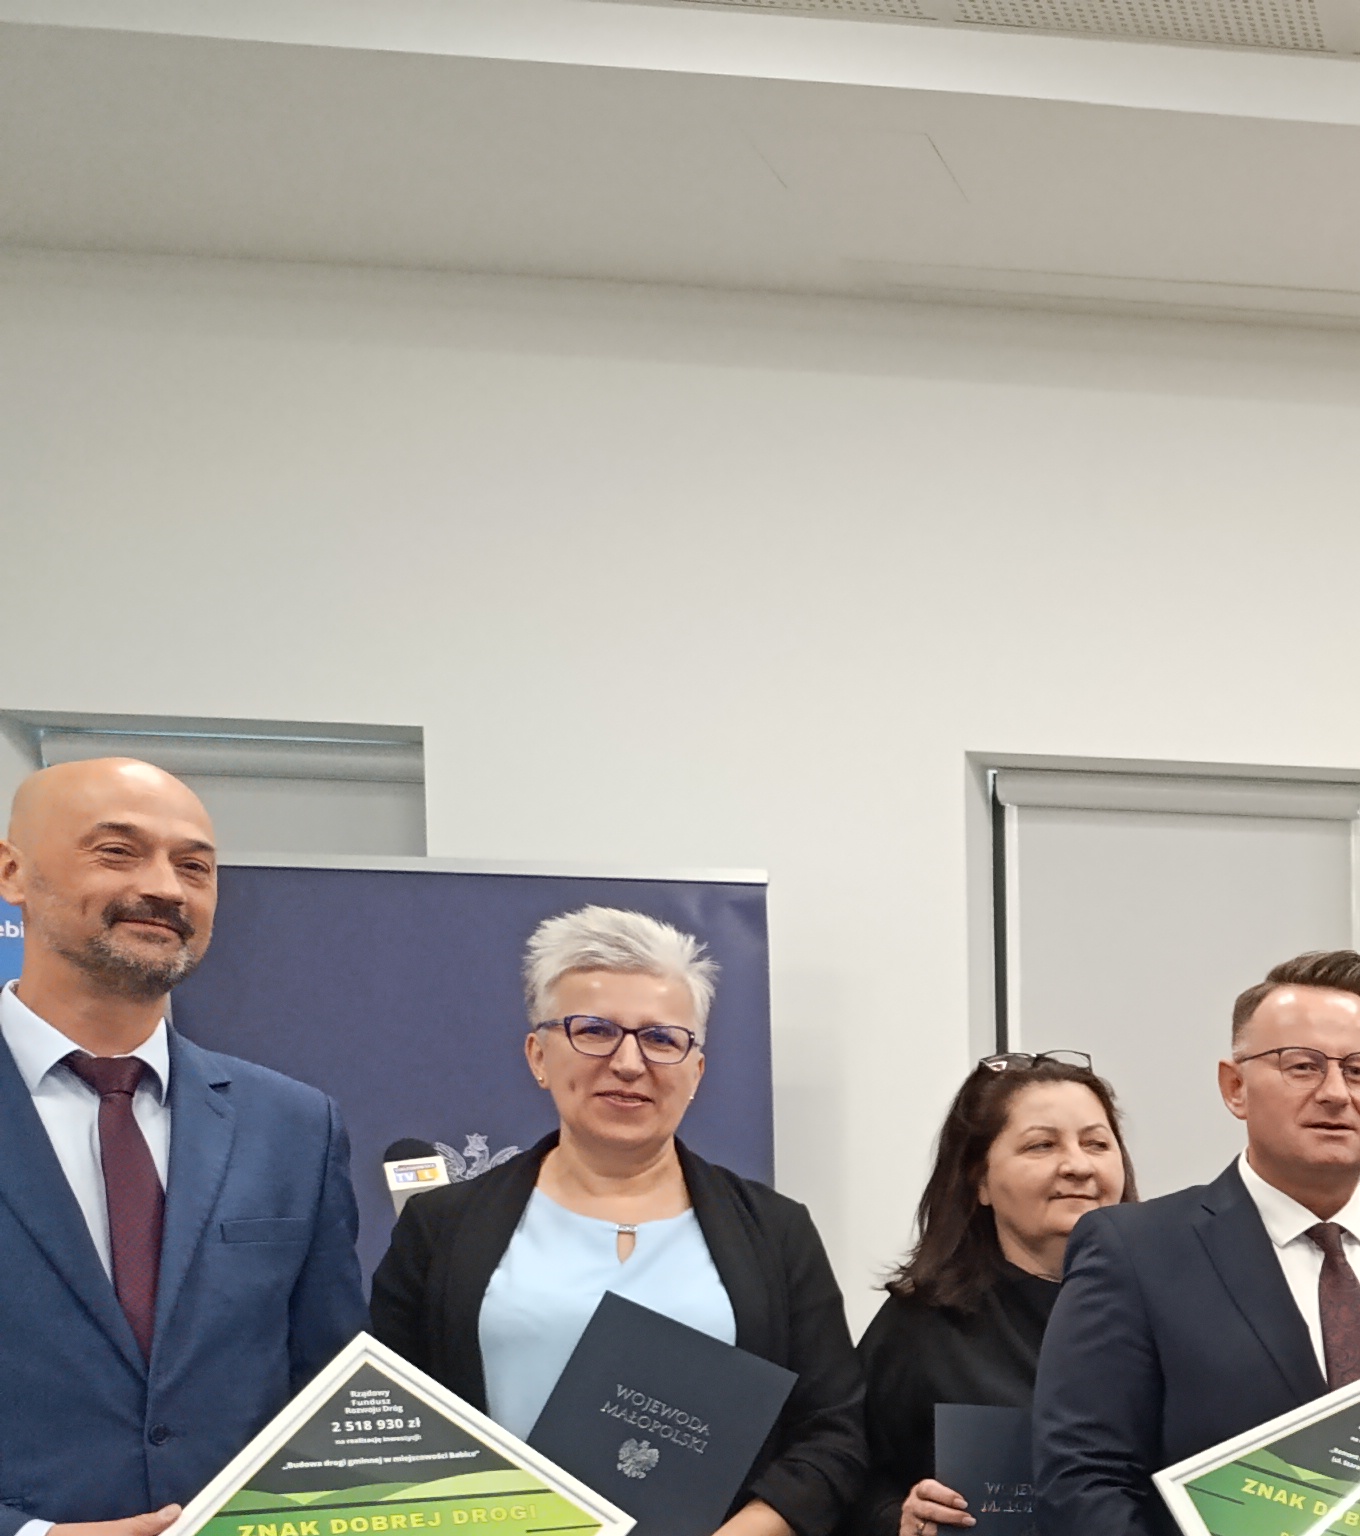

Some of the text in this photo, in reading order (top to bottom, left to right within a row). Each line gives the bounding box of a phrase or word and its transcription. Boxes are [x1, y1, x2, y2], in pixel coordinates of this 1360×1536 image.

[330, 1416, 422, 1434] 2 518 930 zł
[616, 1384, 710, 1436] WOJEWODA
[600, 1401, 708, 1454] MAŁOPOLSKI
[1241, 1478, 1306, 1510] ZNAK
[330, 1510, 443, 1534] DOBREJ
[452, 1503, 538, 1525] DROGI
